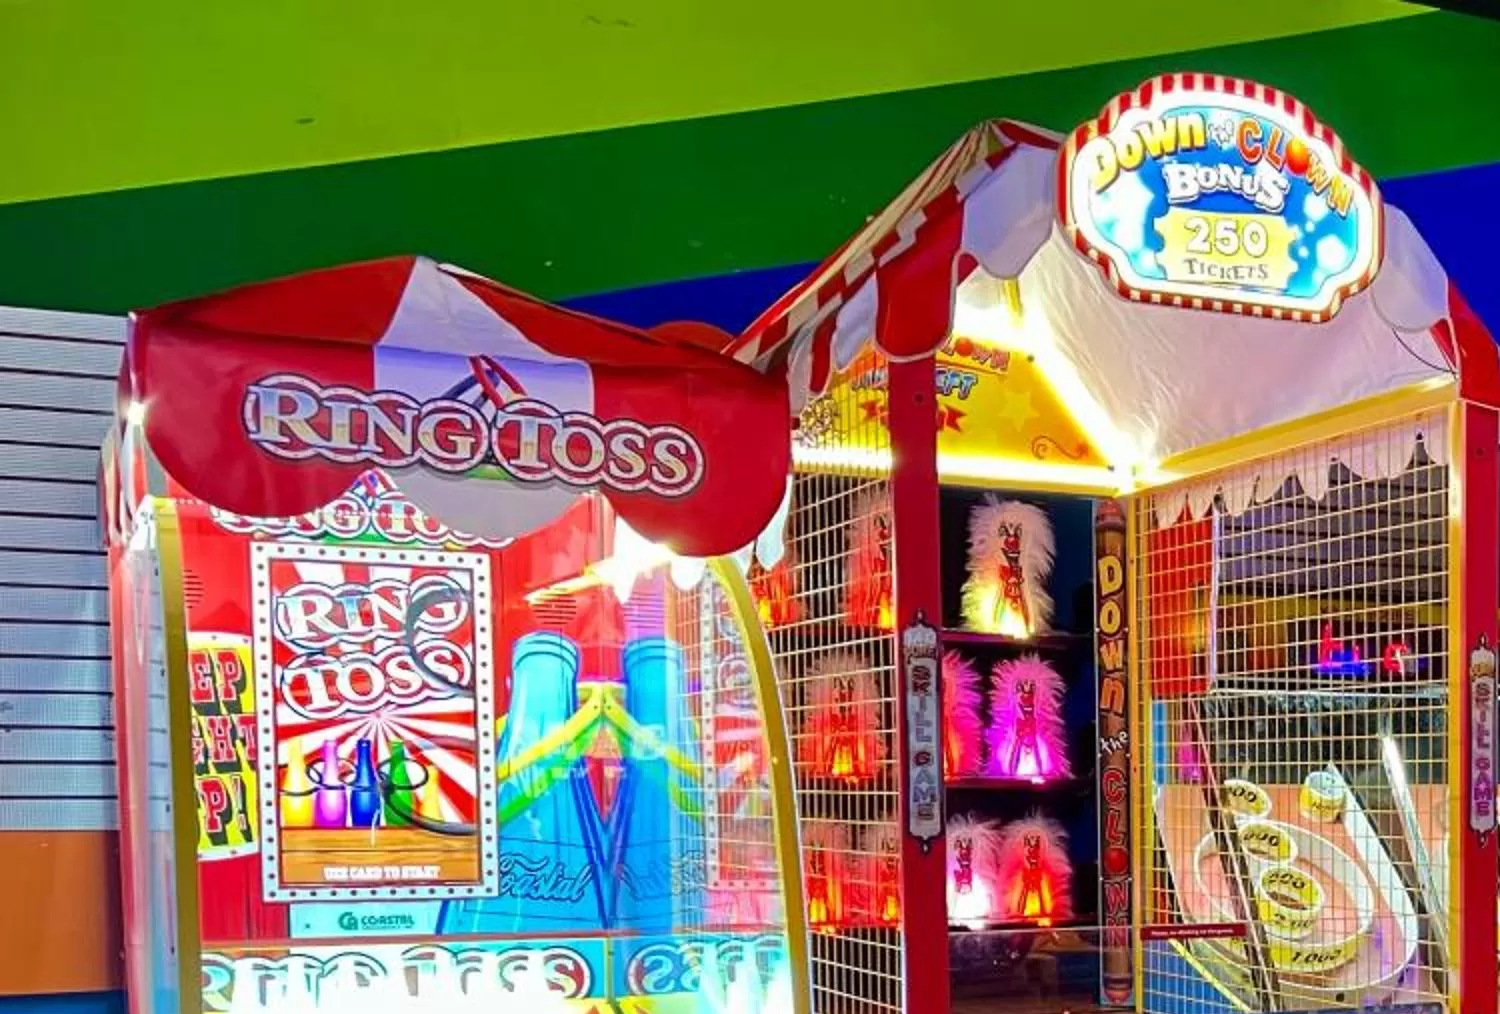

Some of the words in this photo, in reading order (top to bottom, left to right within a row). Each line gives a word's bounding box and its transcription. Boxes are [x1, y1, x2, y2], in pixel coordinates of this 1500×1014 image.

[1164, 162, 1290, 213] BONUS
[1184, 215, 1269, 258] 250
[1184, 257, 1269, 280] TICKETS
[247, 385, 476, 461] RING
[495, 411, 690, 485] TOSS
[277, 588, 459, 640] RING
[285, 649, 464, 710] TOSS
